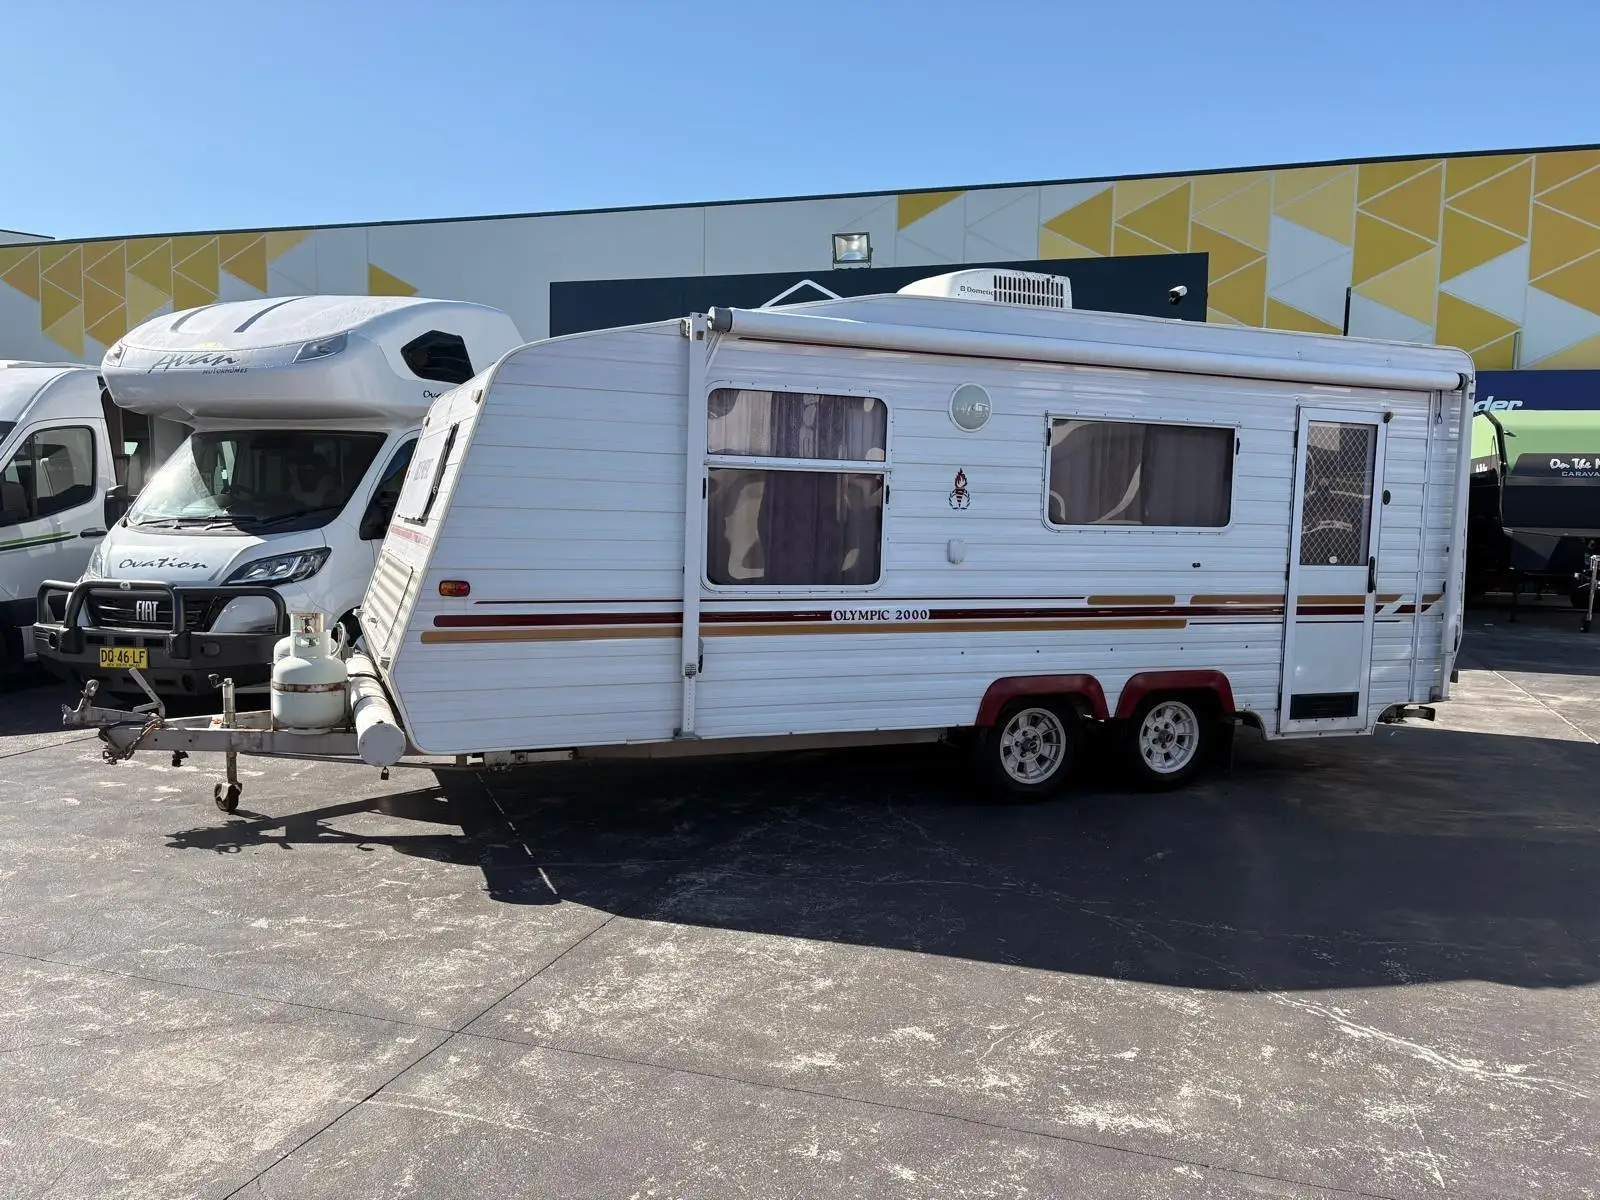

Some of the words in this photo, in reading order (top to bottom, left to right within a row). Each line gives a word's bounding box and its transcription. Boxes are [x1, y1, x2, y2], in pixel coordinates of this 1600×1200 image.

[966, 286, 994, 296] Dometic
[1549, 458, 1570, 469] On
[1571, 458, 1592, 469] The
[119, 557, 209, 569] Ovation
[135, 600, 159, 622] FIAT
[833, 609, 890, 621] OLYMPIC
[895, 609, 928, 620] 2000
